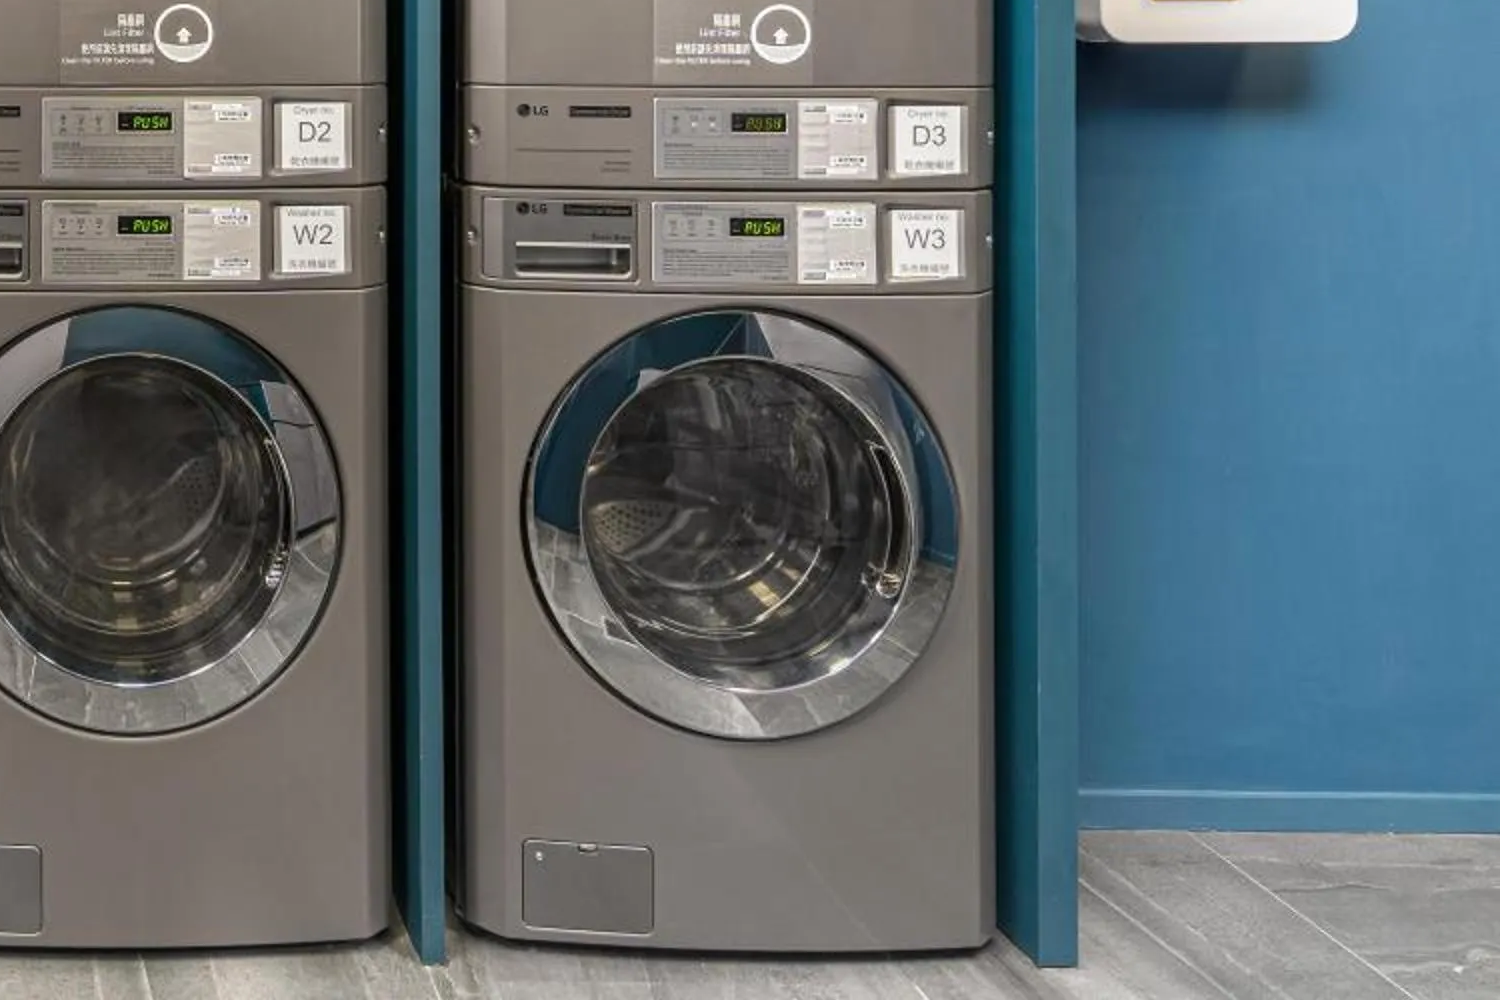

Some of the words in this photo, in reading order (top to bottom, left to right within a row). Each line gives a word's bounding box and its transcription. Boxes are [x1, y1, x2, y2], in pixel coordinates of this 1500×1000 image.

[132, 115, 170, 129] PUSH
[299, 121, 332, 143] D2
[913, 124, 947, 146] D3
[133, 219, 170, 233] PUSH
[293, 223, 333, 245] W2
[744, 221, 781, 235] PUSH
[904, 228, 946, 250] W3
